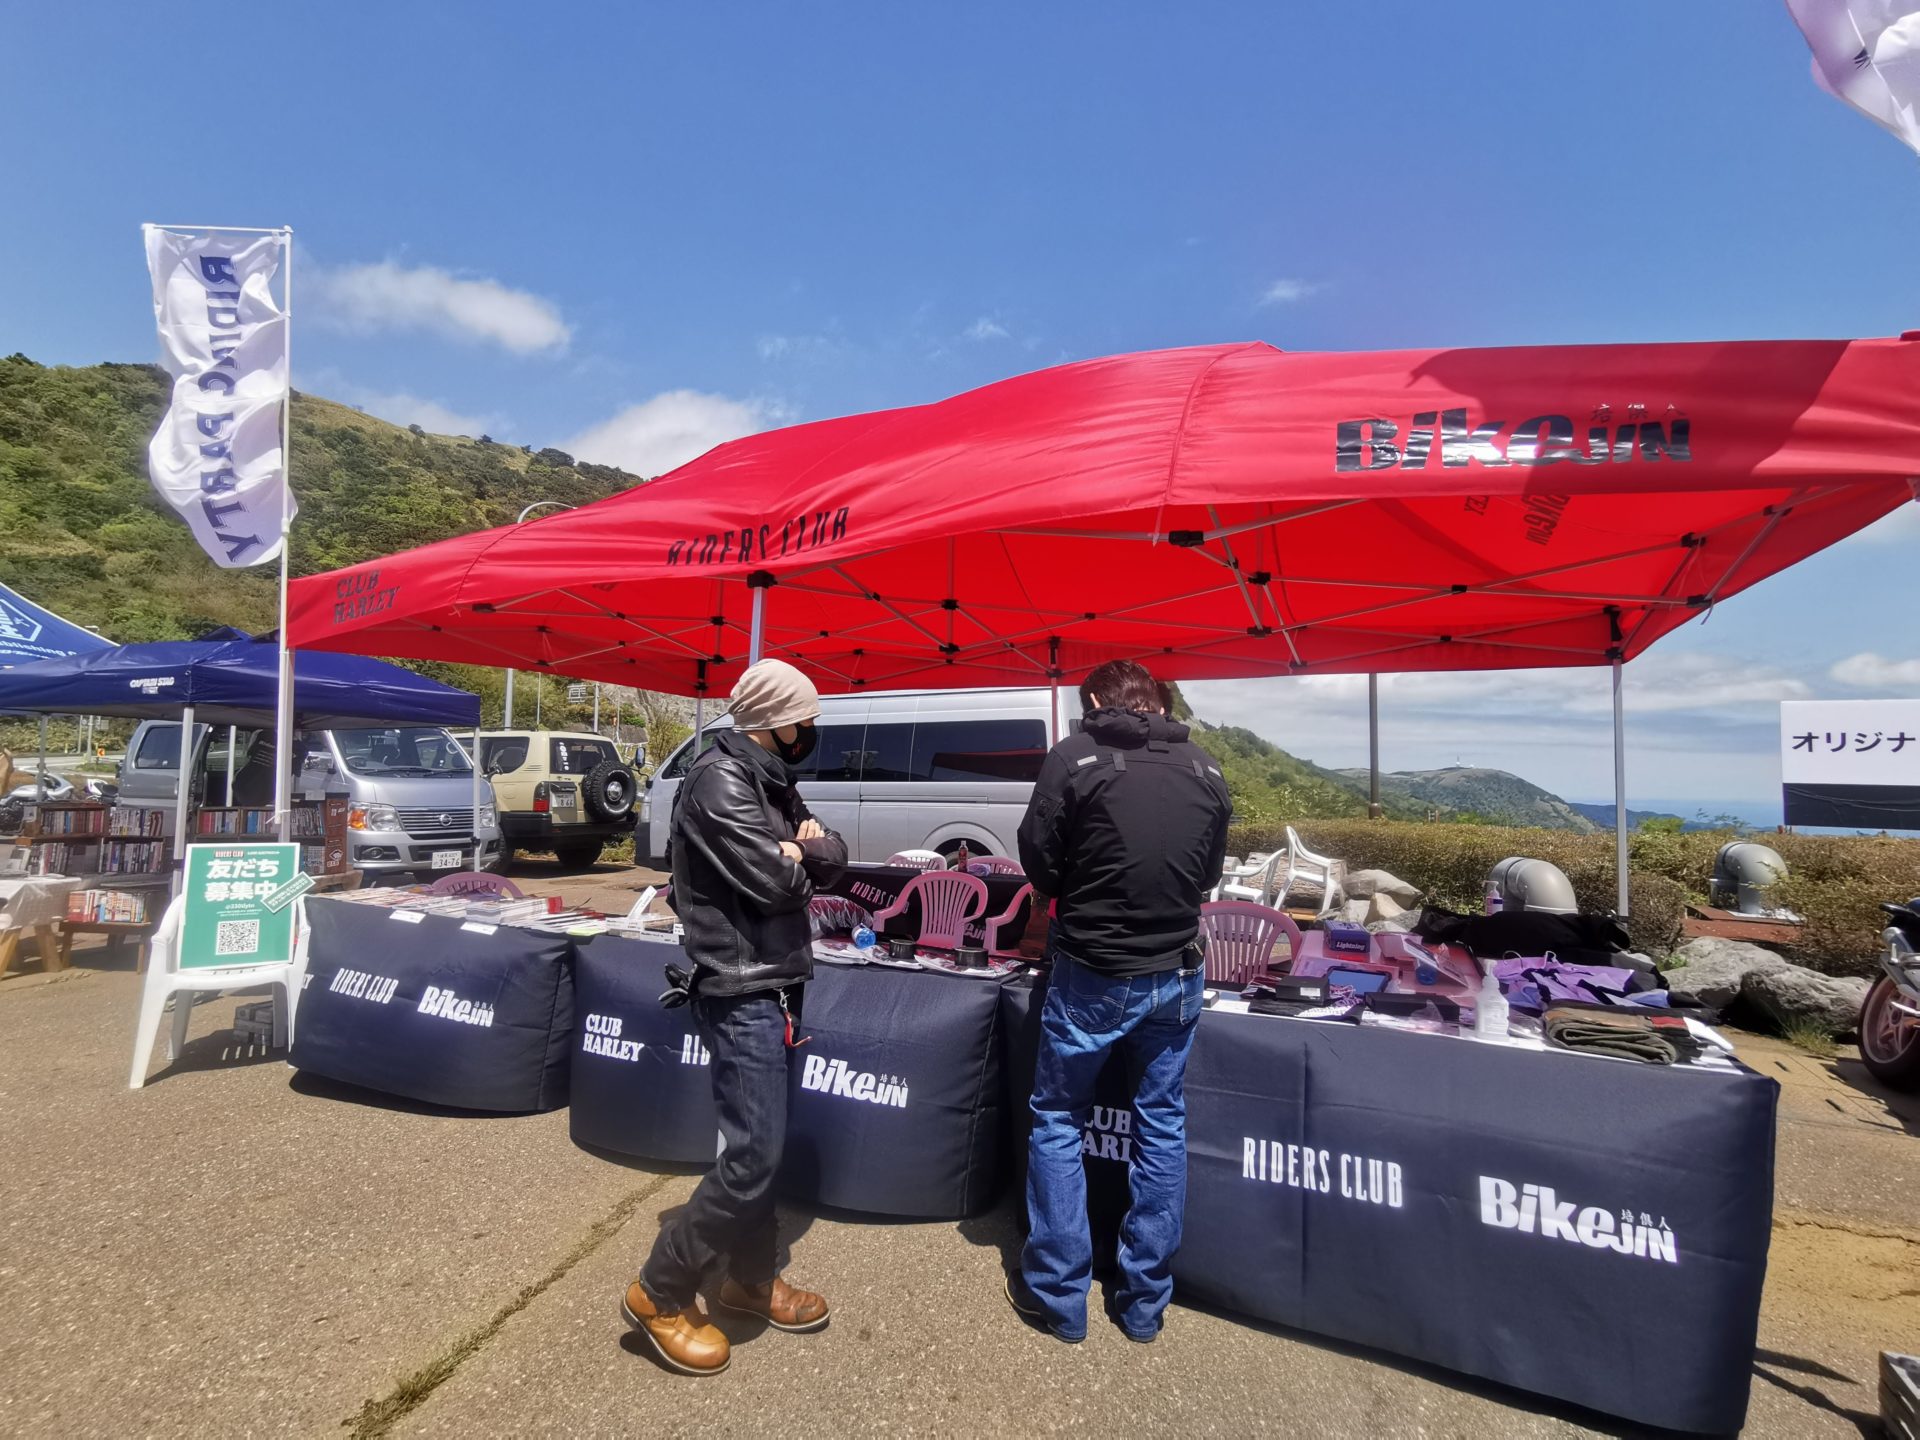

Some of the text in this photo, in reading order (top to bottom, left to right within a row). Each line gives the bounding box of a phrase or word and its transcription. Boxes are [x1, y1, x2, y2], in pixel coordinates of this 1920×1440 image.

[337, 570, 381, 599] CLUB
[333, 586, 400, 624] HARLEY
[1792, 732, 1916, 752] オリジナ
[206, 858, 280, 879] 友だち
[205, 880, 278, 902] 募集中
[850, 881, 887, 905] RIDERS
[329, 968, 372, 999] RIDERS
[365, 976, 400, 1005] CLUB
[585, 1013, 623, 1037] CLUB
[582, 1032, 645, 1062] HARLEY
[1242, 1136, 1403, 1208] RIDERS CLUB
